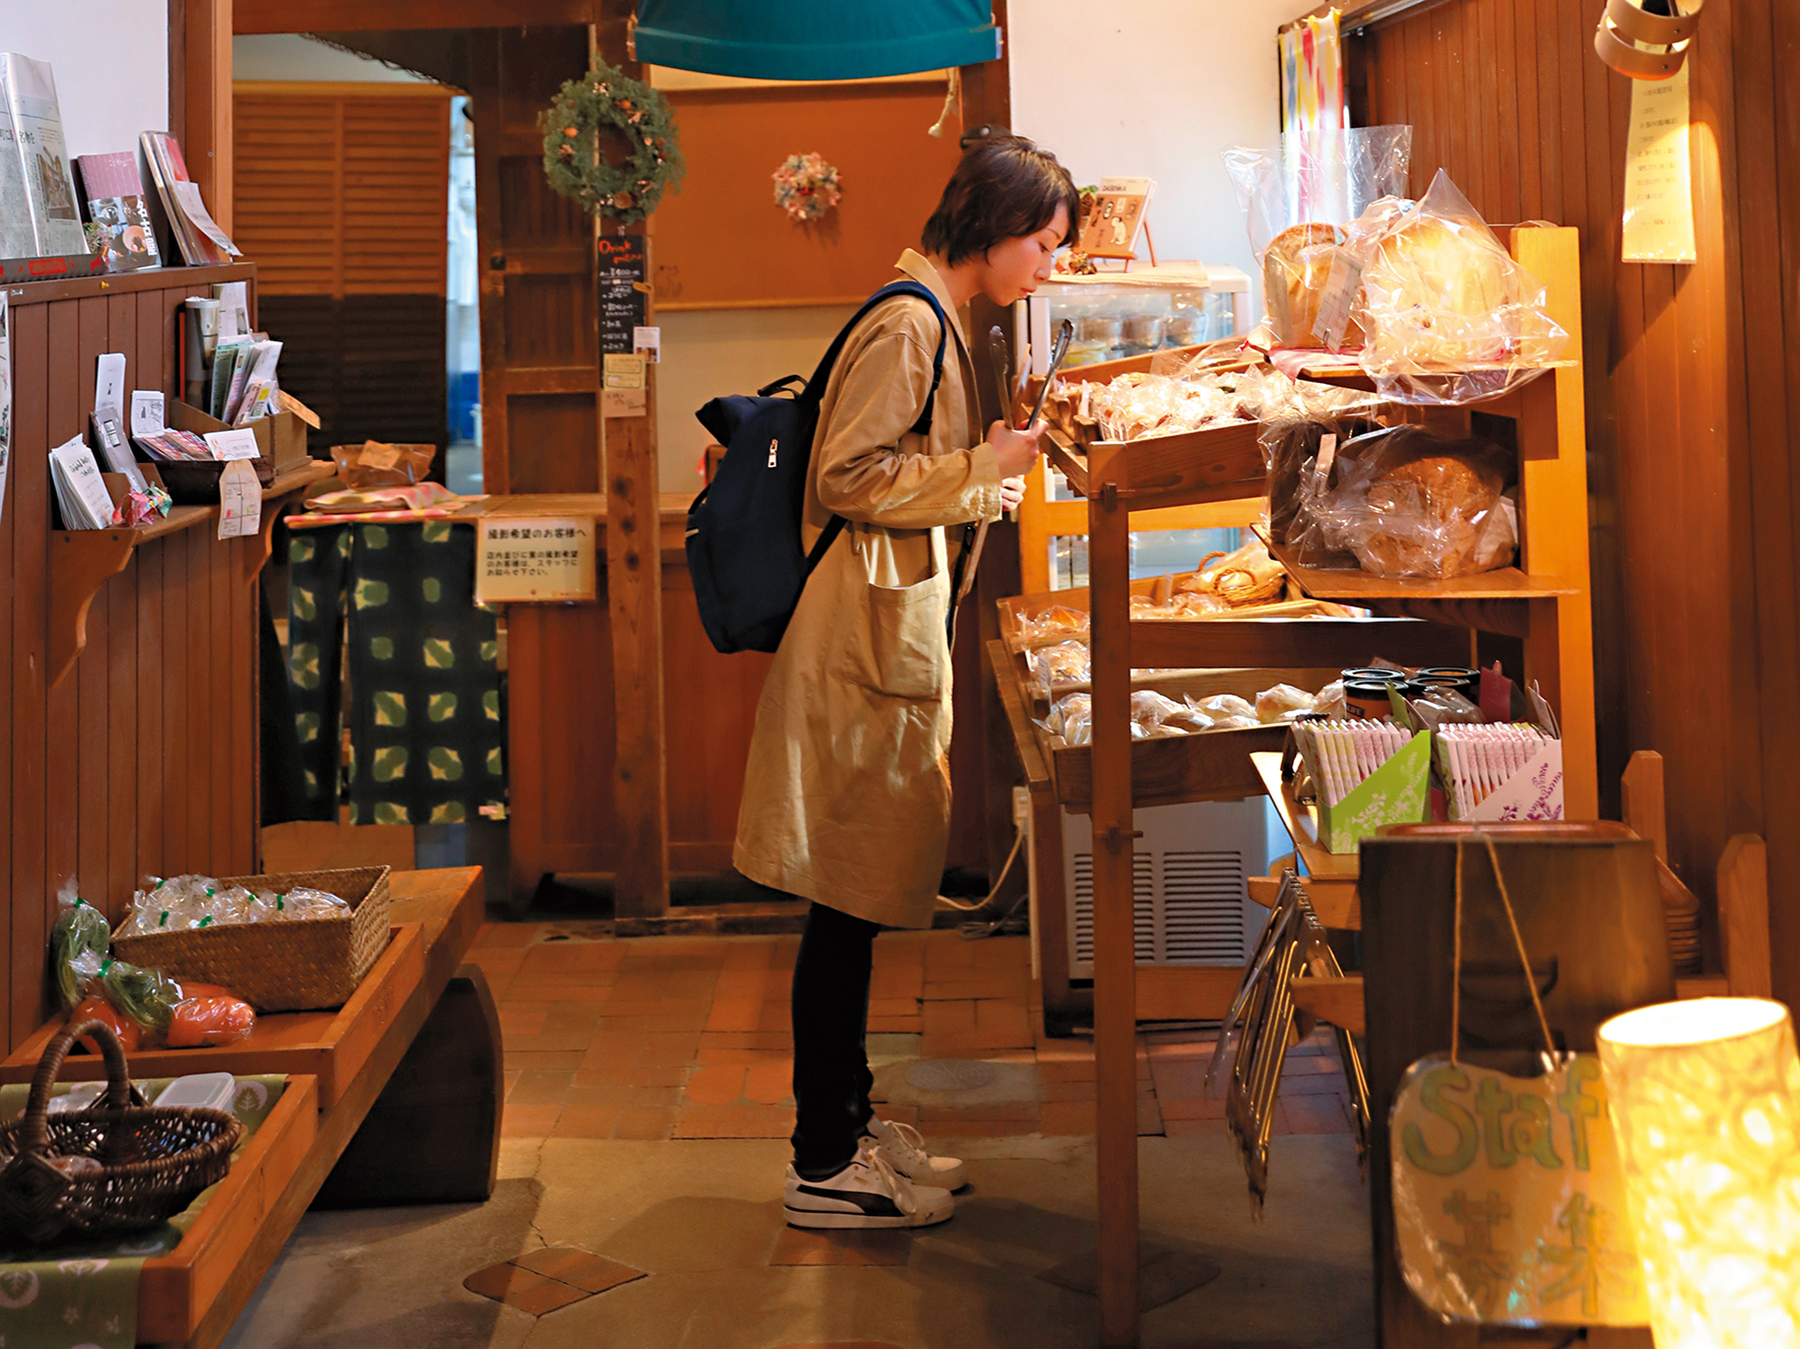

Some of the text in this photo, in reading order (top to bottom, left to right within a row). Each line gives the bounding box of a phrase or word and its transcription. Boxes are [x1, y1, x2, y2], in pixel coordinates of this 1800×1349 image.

[136, 199, 158, 256] 名古屋
[487, 528, 587, 540] 撮影希望のお客様へ
[1402, 1057, 1608, 1176] Staf
